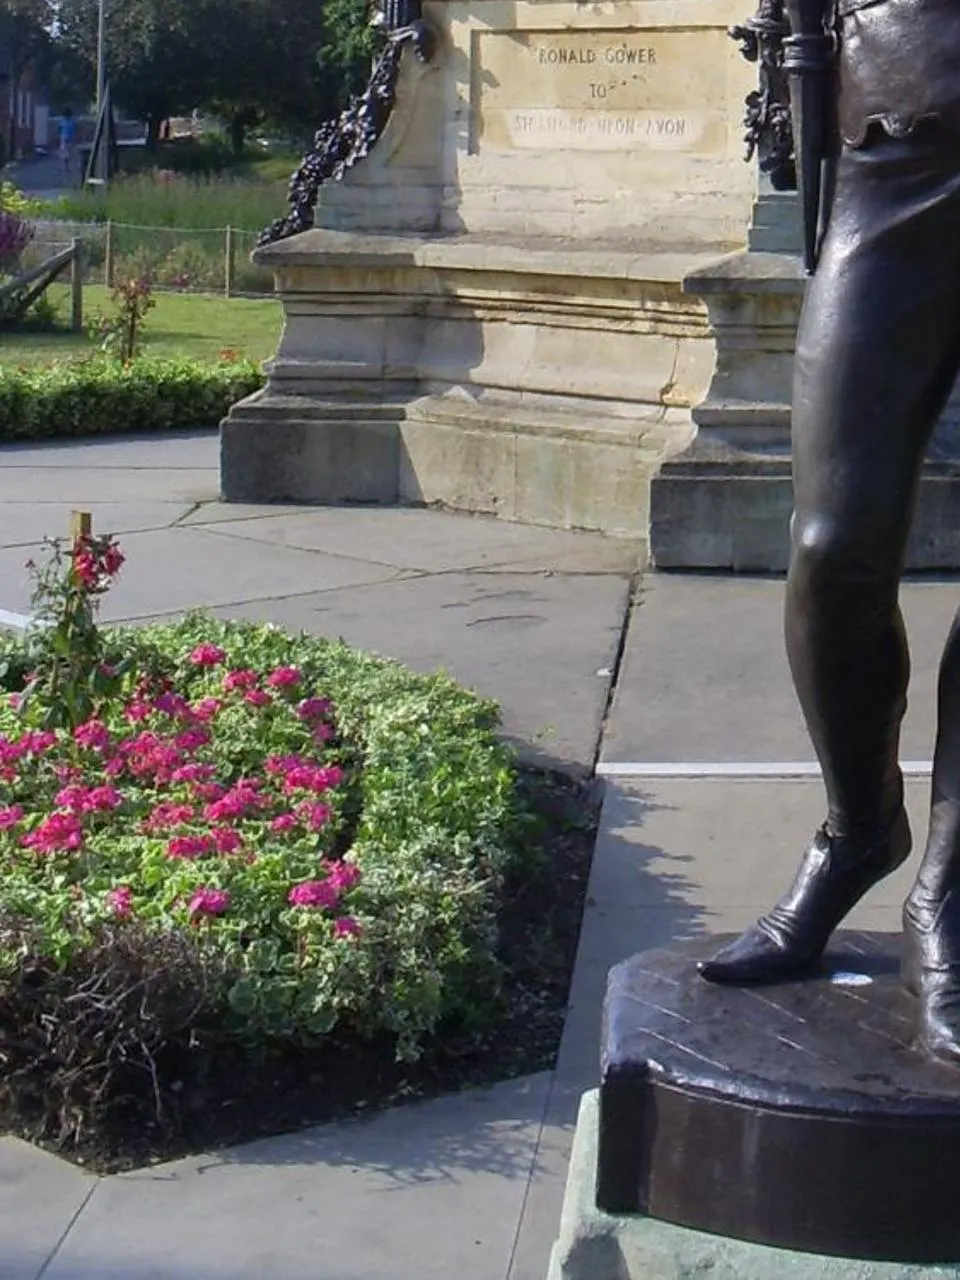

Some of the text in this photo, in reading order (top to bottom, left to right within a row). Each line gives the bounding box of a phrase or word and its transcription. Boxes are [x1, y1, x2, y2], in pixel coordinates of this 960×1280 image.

[539, 47, 657, 65] RONALD GOWER
[589, 83, 607, 98] TO
